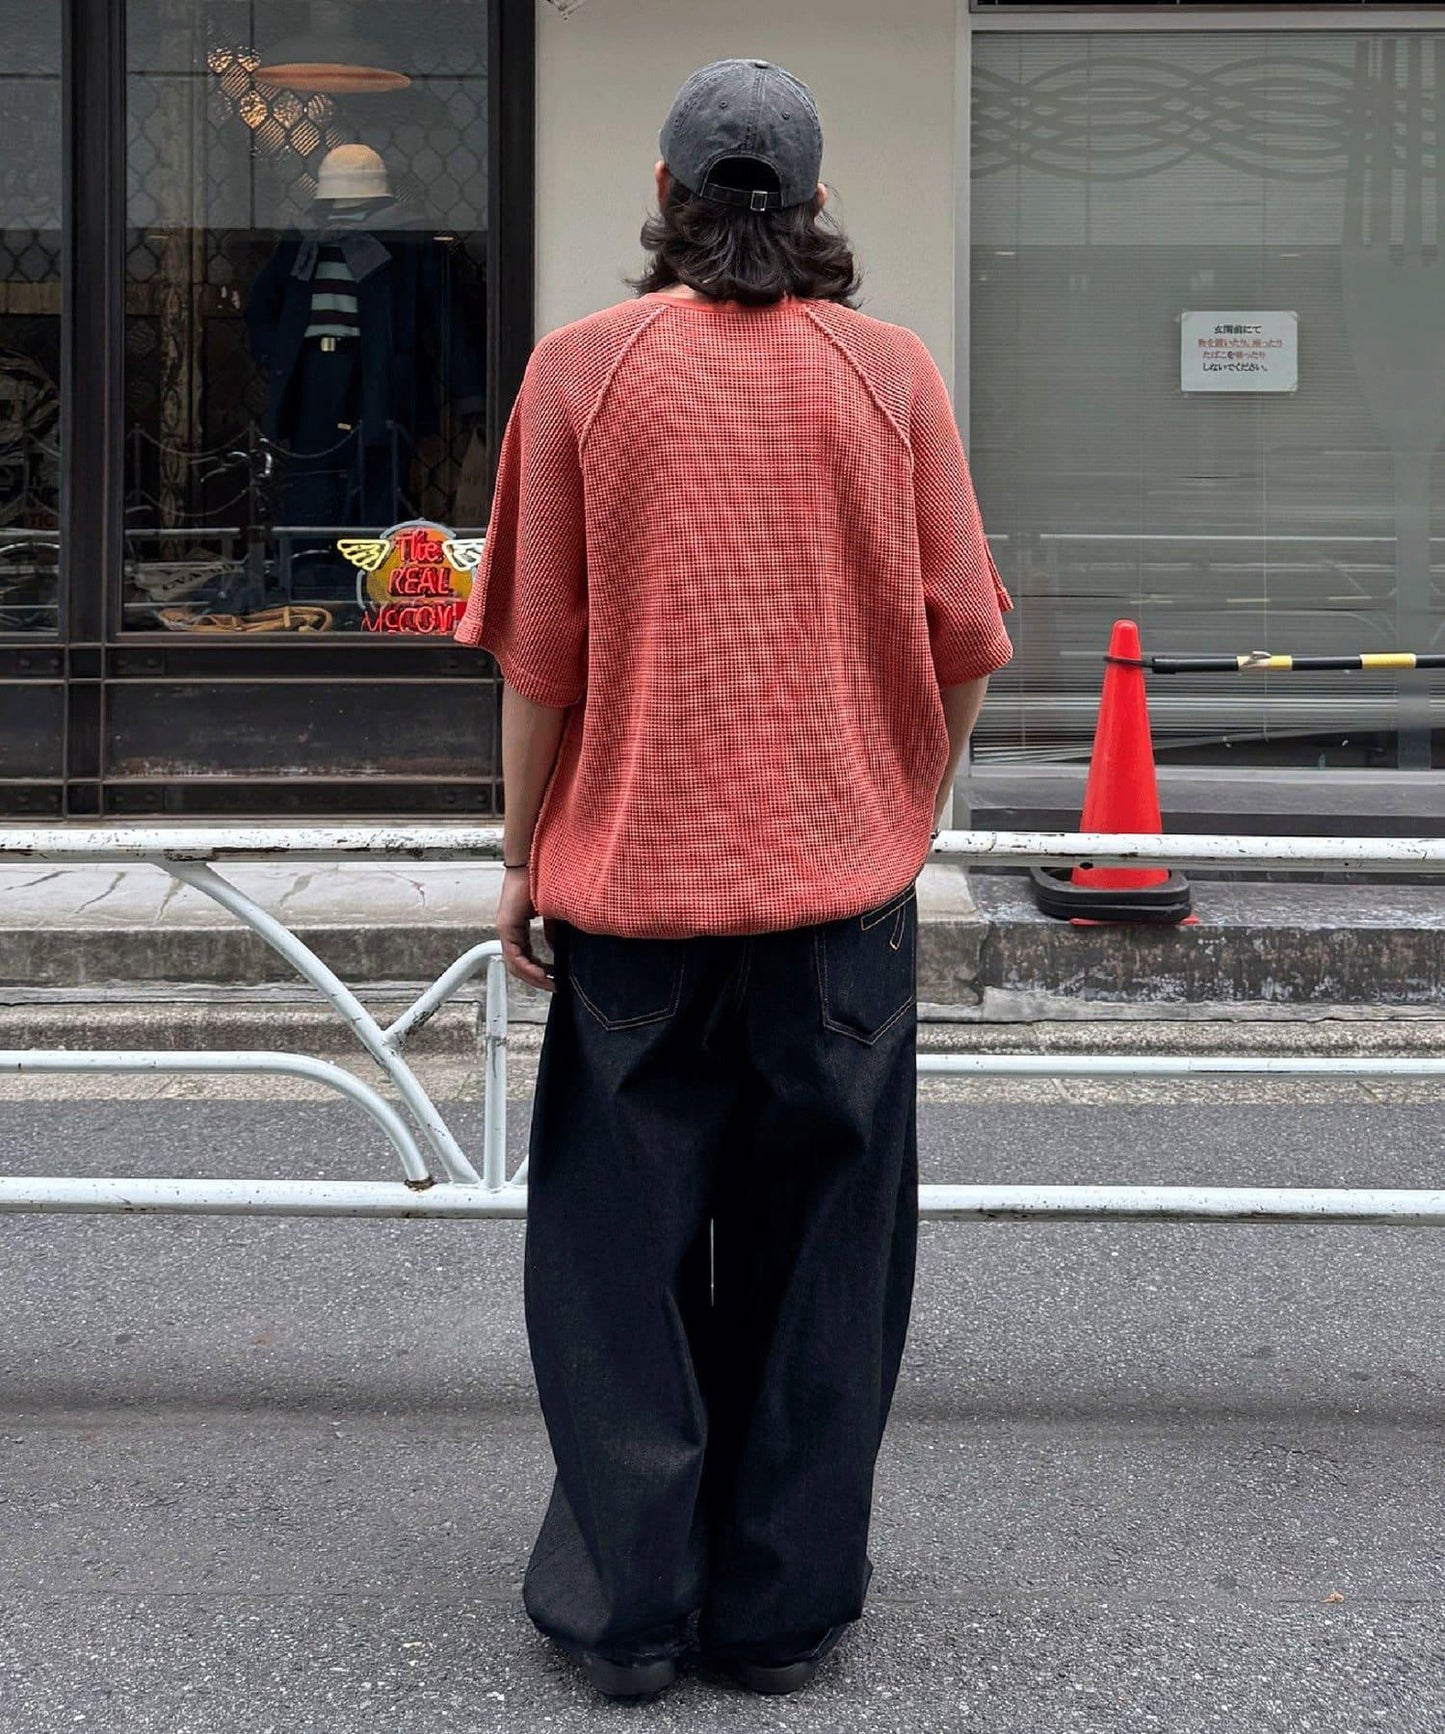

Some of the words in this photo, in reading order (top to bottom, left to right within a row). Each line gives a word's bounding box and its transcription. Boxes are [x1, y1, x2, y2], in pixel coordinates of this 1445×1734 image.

[1214, 325, 1262, 335] 玄関前にて
[396, 529, 439, 563] The
[387, 567, 451, 594] REAL
